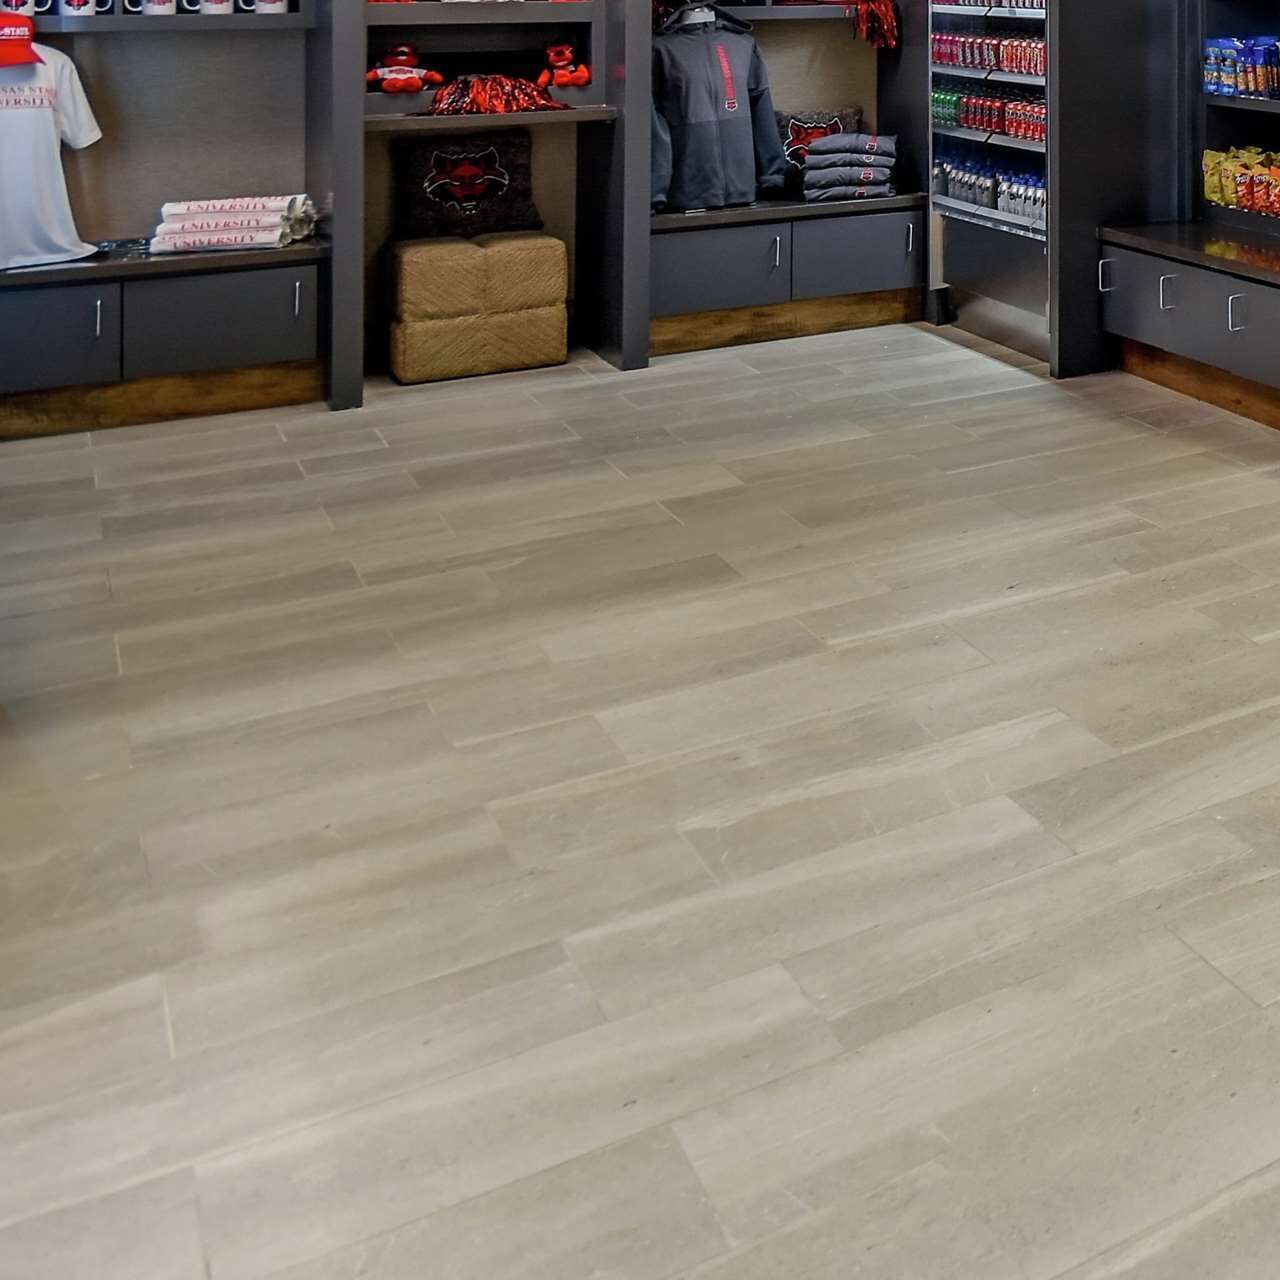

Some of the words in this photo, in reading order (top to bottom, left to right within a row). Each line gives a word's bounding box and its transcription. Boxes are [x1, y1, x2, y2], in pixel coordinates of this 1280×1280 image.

[186, 201, 269, 213] UNIVERSITY
[181, 218, 263, 231] UNIVERSITY
[173, 234, 257, 250] UNIVERSITY
